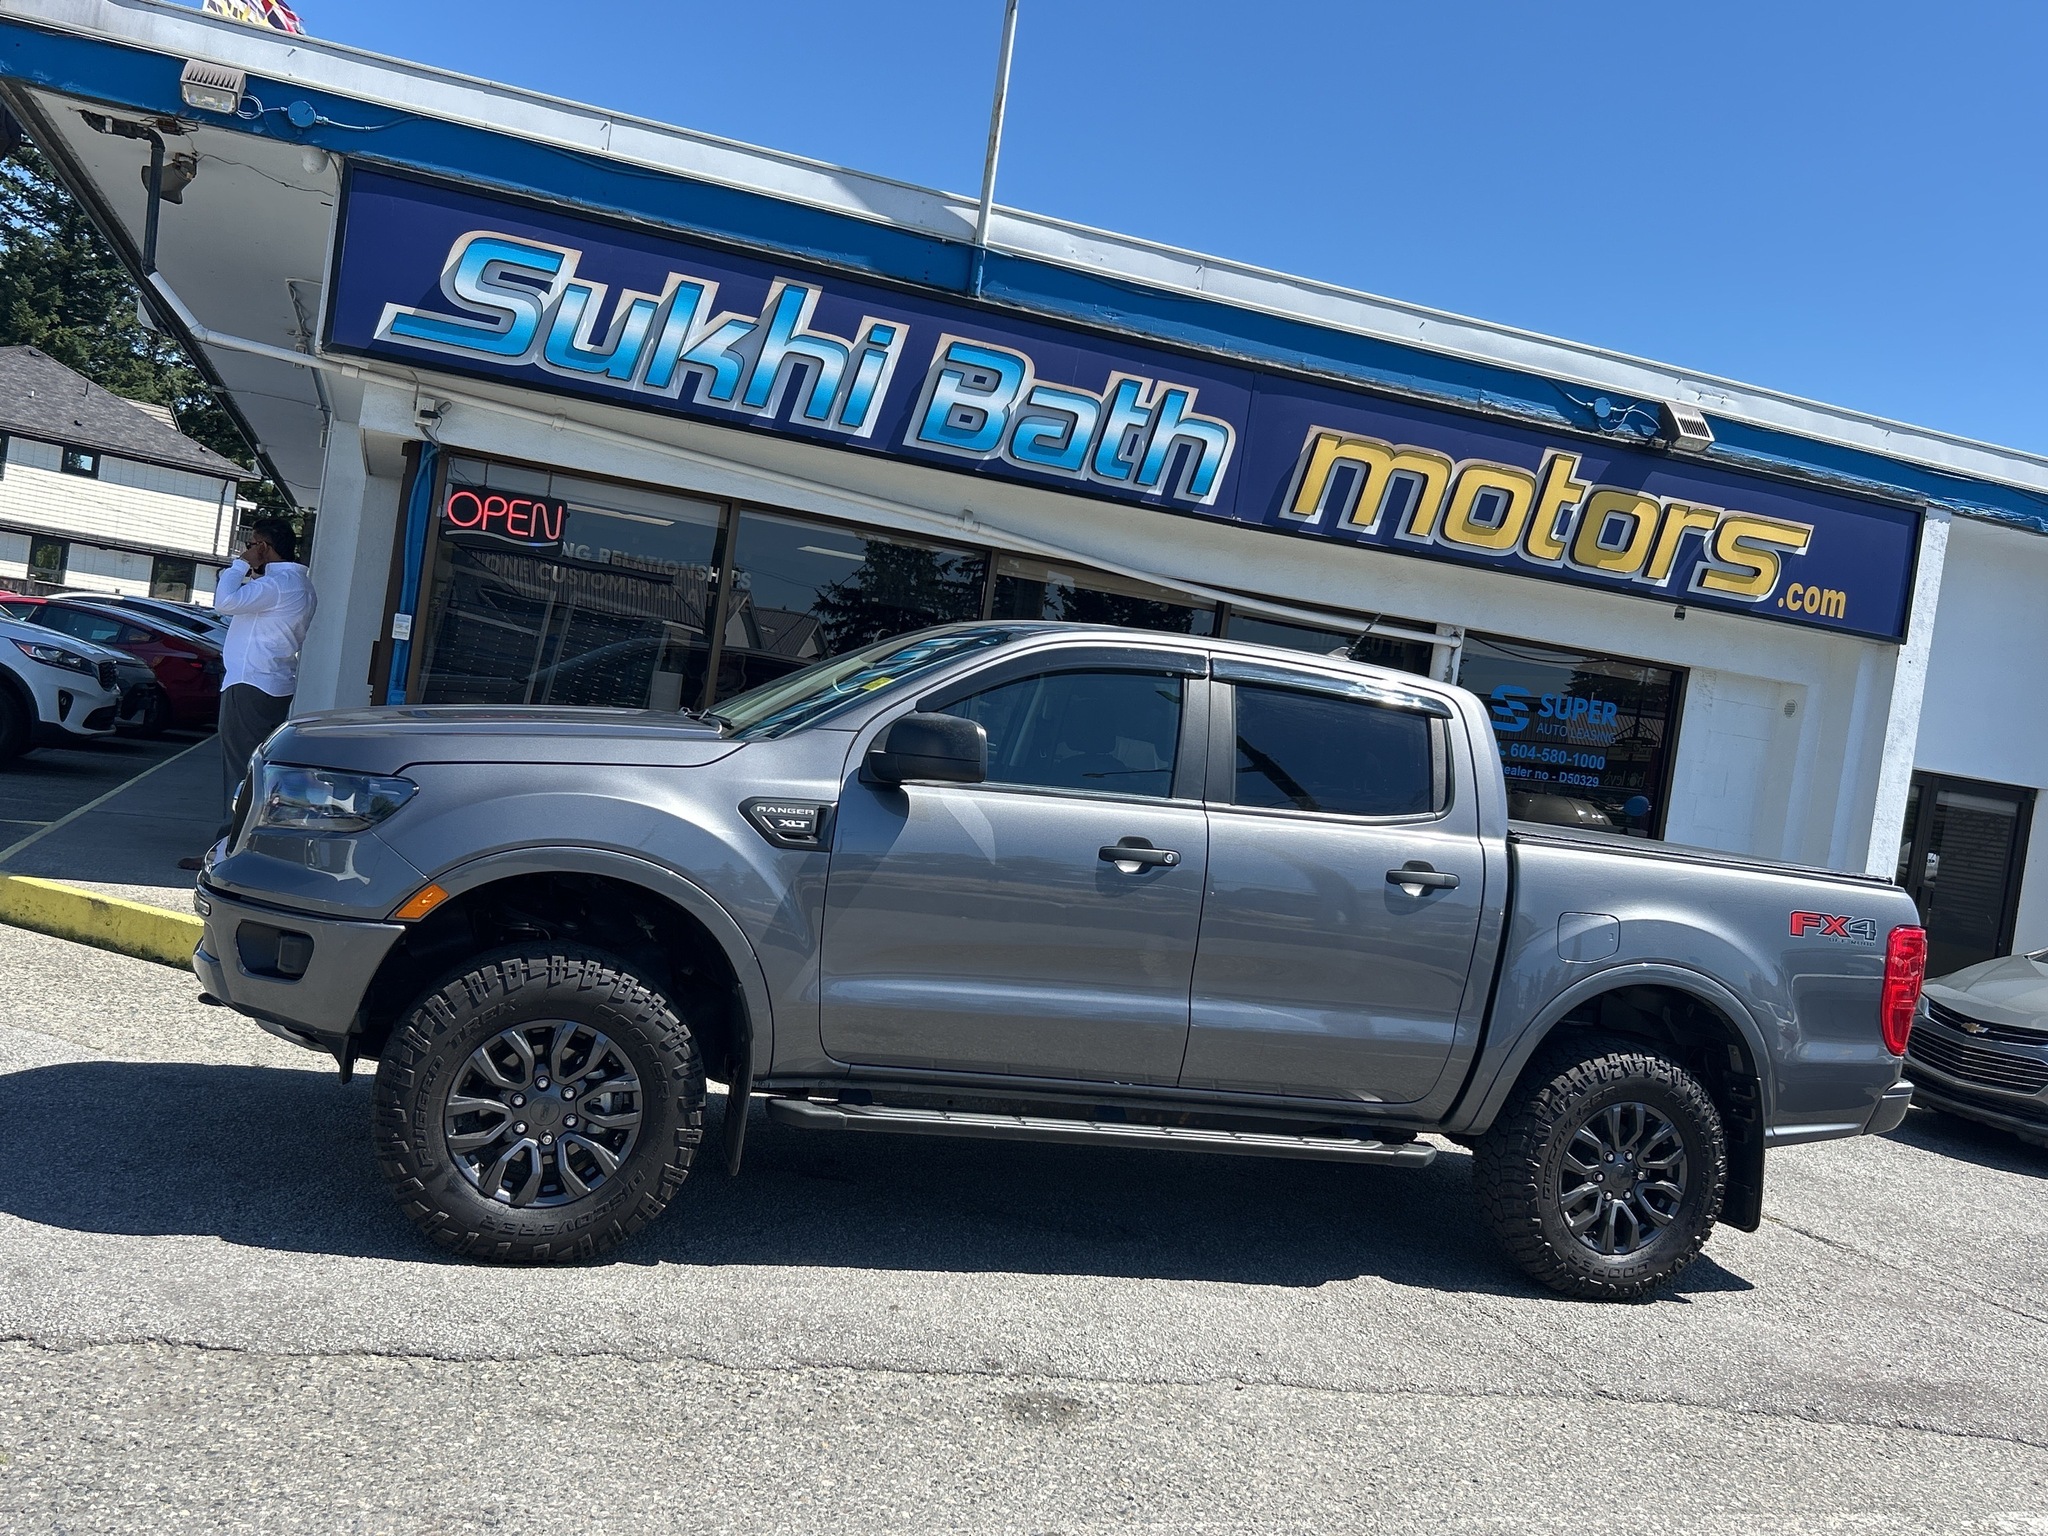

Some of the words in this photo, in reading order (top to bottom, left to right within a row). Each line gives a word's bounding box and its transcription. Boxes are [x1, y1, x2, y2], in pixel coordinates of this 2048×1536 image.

[373, 230, 912, 438] Sukhi
[903, 331, 1237, 506] Bath
[446, 491, 564, 541] OPEN
[1278, 424, 1815, 603] motors
[1777, 581, 1847, 621] .com
[537, 563, 650, 597] CUSTOMER
[598, 547, 752, 590] RELATIONSHPS
[1538, 692, 1618, 727] SUPER
[1536, 722, 1567, 737] AUTO
[1569, 727, 1616, 744] LEASING
[1510, 743, 1606, 770] 604-580-1000
[1502, 764, 1532, 779] ealer
[1534, 771, 1549, 781] no
[1559, 771, 1599, 788] D50329
[756, 806, 815, 816] RANGER
[778, 820, 810, 828] XLT
[1789, 909, 1878, 941] FX4
